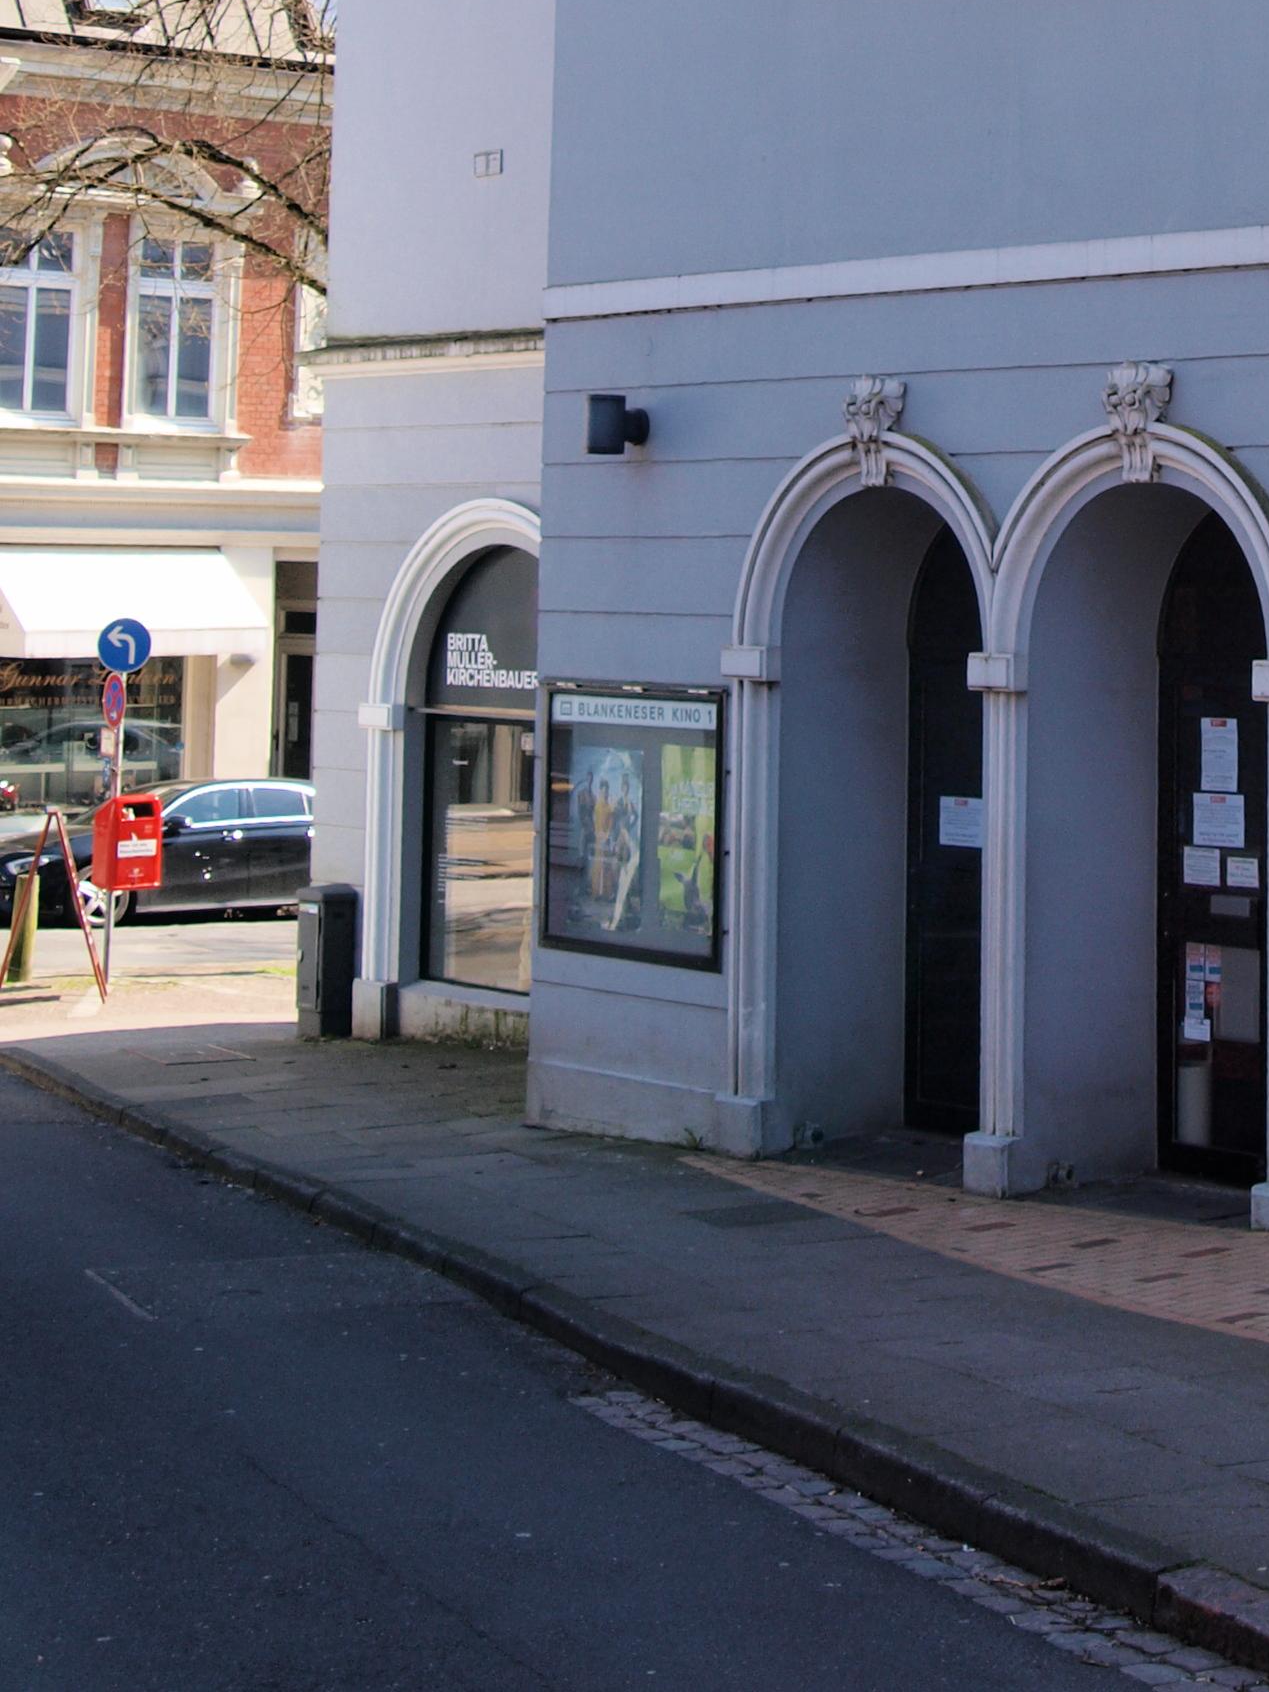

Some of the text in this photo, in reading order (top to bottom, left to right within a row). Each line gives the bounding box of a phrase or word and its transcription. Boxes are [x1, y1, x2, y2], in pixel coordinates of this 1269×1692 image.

[447, 632, 488, 651] BRITTA
[446, 668, 539, 689] KIRCHENBAUER
[578, 702, 713, 724] BLANKENESER KINO 1
